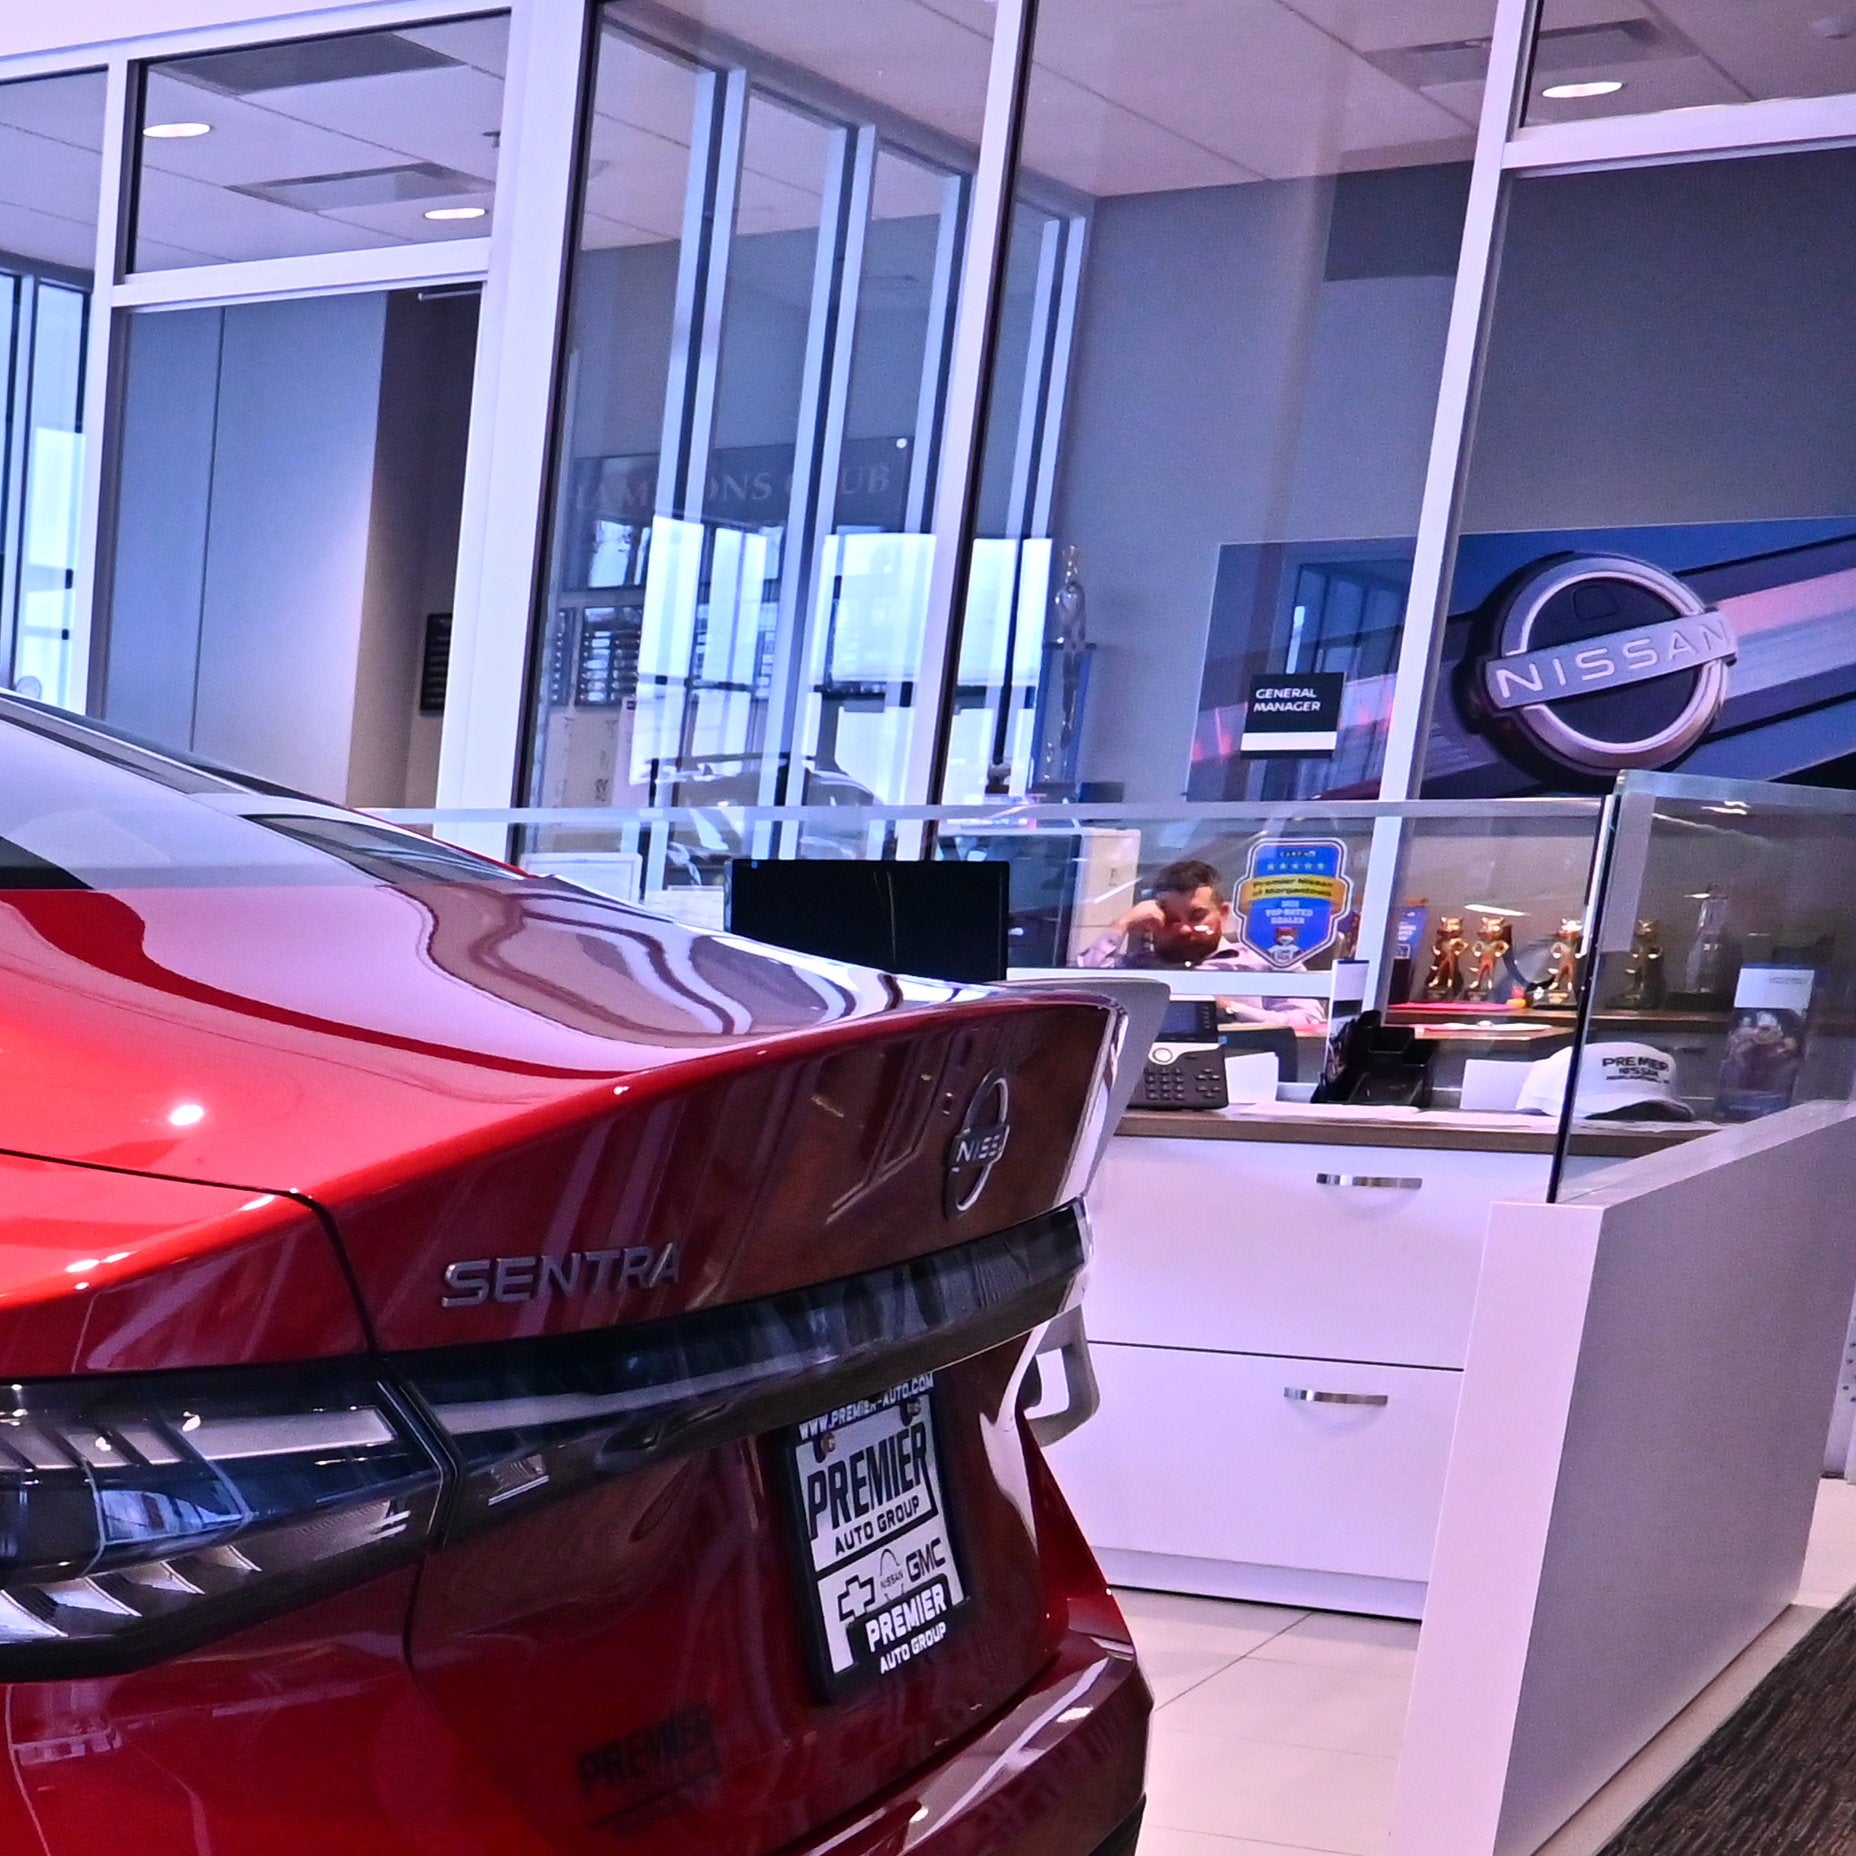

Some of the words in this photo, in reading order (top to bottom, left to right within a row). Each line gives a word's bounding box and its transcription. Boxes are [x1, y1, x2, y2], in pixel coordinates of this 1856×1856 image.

[1495, 619, 1729, 699] NISSAN
[1253, 701, 1322, 712] MANAGER
[1255, 687, 1318, 699] GENERAL
[441, 1242, 681, 1308] SENTRA
[807, 1421, 929, 1542] PREMIER
[835, 1514, 874, 1557] AUTO
[878, 1494, 920, 1534] GROUP
[906, 1537, 946, 1584] GMC
[865, 1583, 948, 1653] PREMIER
[880, 1640, 910, 1675] AUTO
[913, 1621, 947, 1657] GROUP
